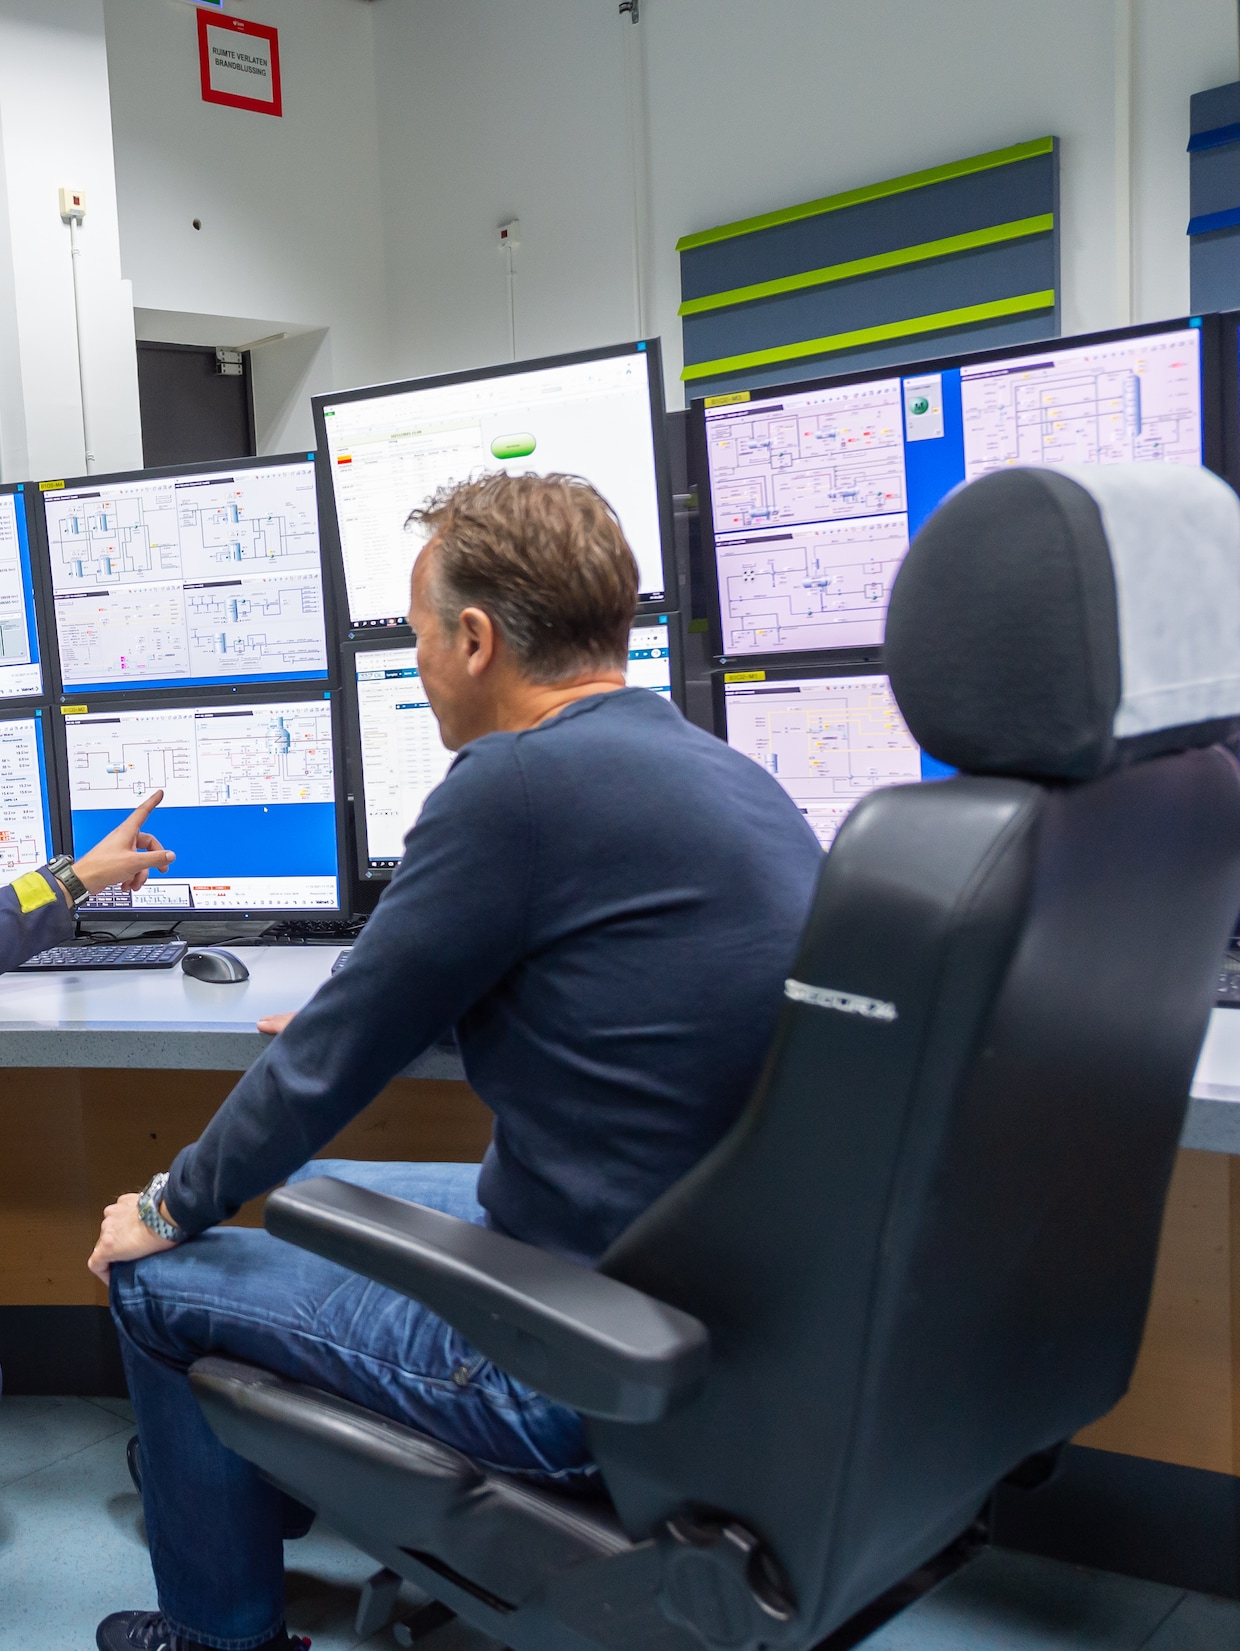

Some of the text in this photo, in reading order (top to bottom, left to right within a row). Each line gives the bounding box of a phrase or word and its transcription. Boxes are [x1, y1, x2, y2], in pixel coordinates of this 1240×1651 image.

[212, 47, 268, 67] RUIMTE VERLATEN
[215, 58, 266, 76] BRANDBLUSSING
